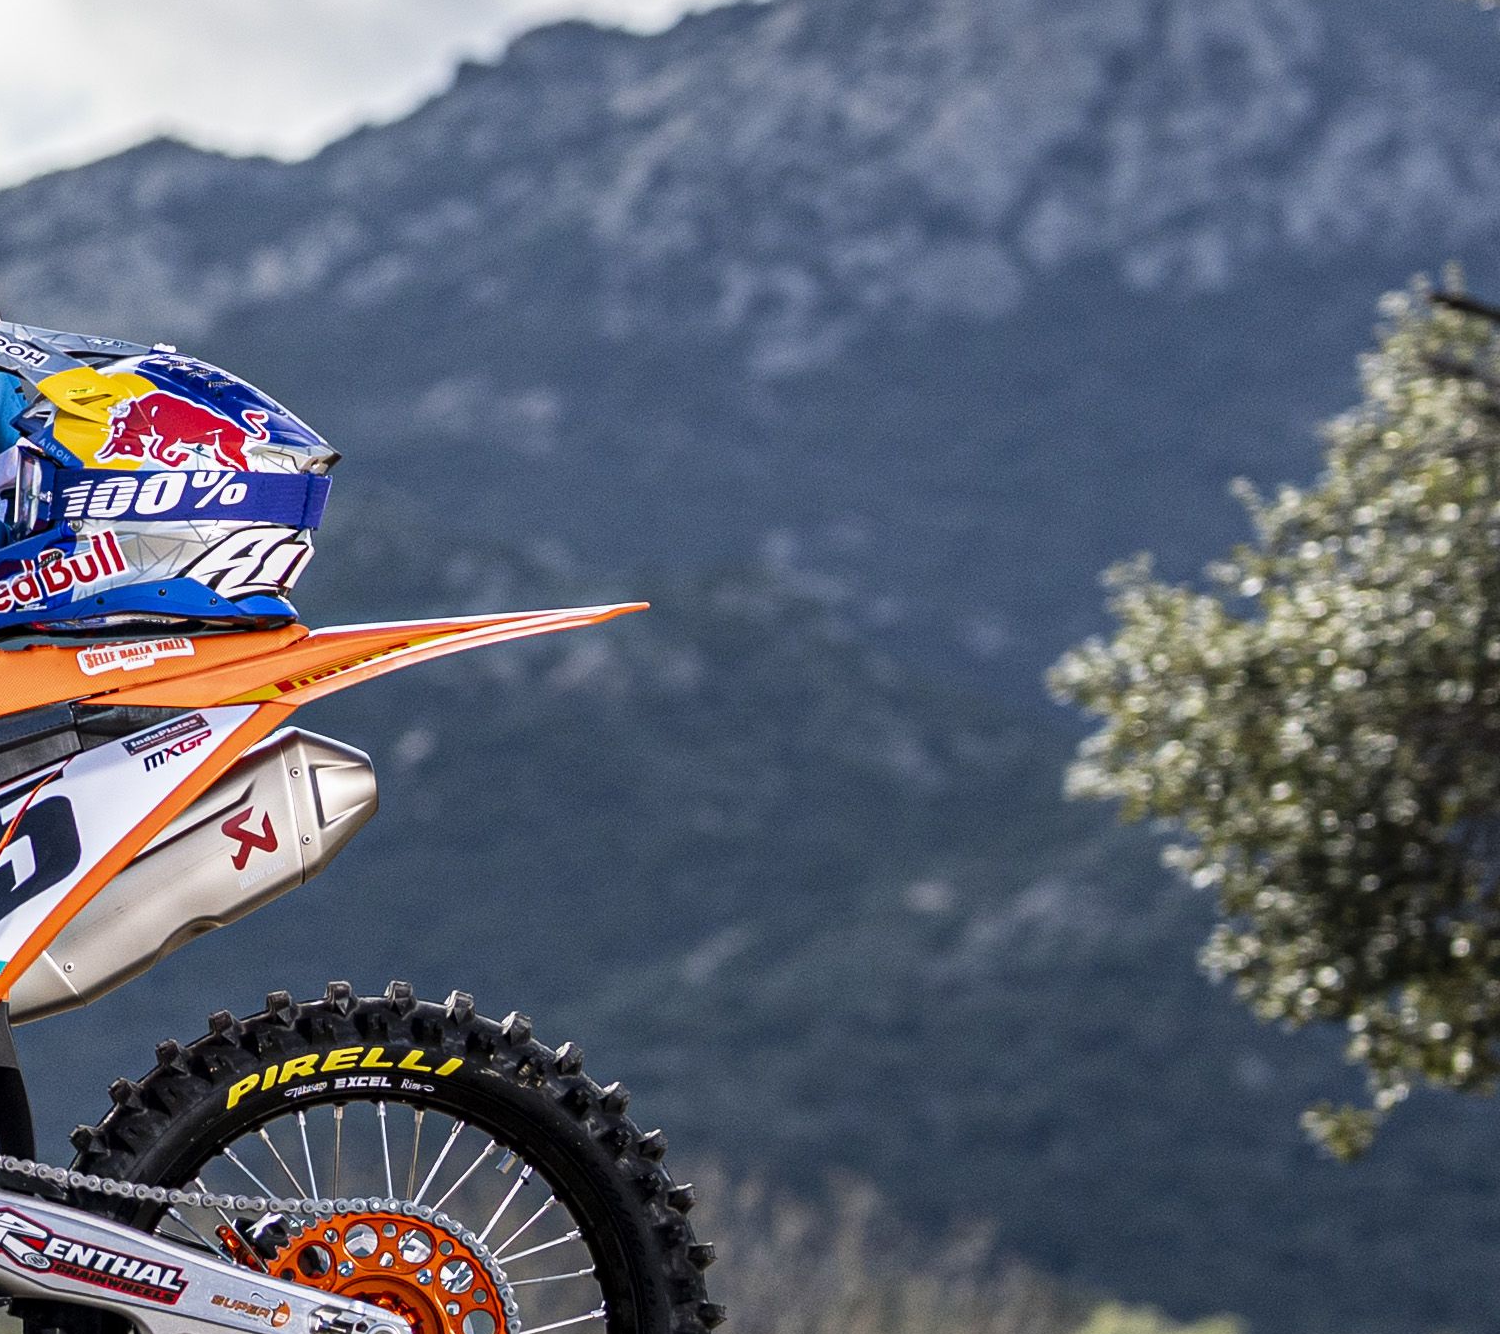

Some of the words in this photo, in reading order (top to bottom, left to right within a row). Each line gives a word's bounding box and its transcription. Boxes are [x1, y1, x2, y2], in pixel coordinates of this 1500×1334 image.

[38, 438, 71, 462] AIROH
[63, 471, 248, 519] 100%
[37, 529, 129, 596] Bull
[84, 652, 116, 669] SELLE
[155, 639, 188, 652] VALLE
[143, 729, 213, 772] MXGP
[226, 1047, 463, 1109] PIRELLI
[334, 1076, 392, 1089] EXCEL
[401, 1078, 435, 1092] Rim
[53, 1263, 176, 1304] CHAINWHEELS
[211, 1294, 269, 1319] SUPER
